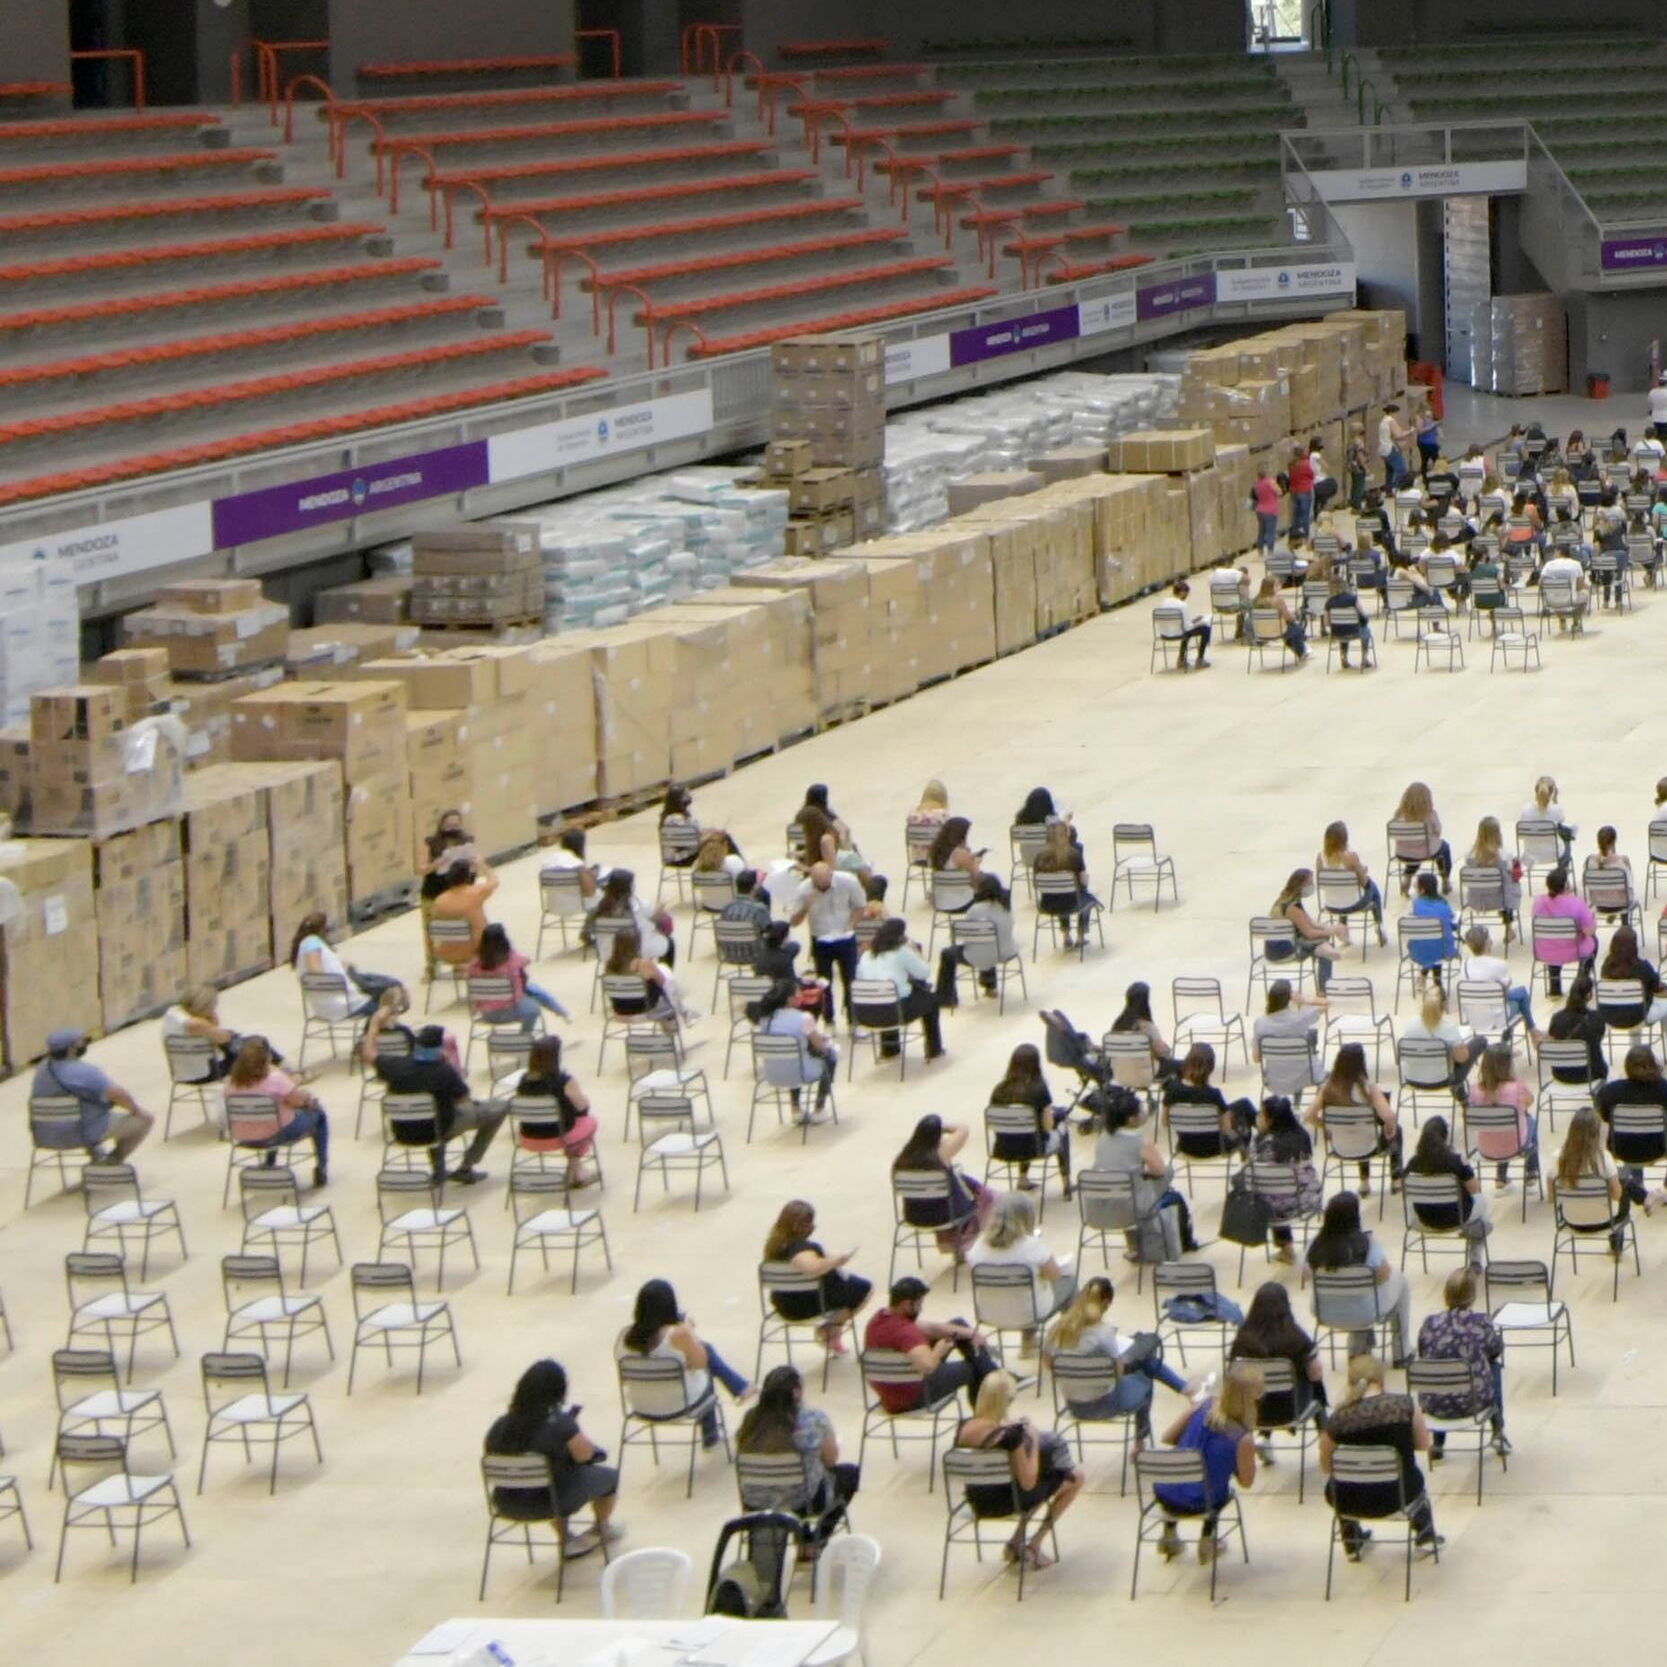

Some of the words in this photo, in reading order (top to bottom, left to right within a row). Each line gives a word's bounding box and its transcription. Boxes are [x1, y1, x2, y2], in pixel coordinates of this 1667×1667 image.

[1418, 170, 1460, 180] MENDOZA
[1614, 248, 1653, 259] MENDOZA
[1296, 269, 1343, 280] MENDOZA
[58, 533, 120, 559] MENDOZA
